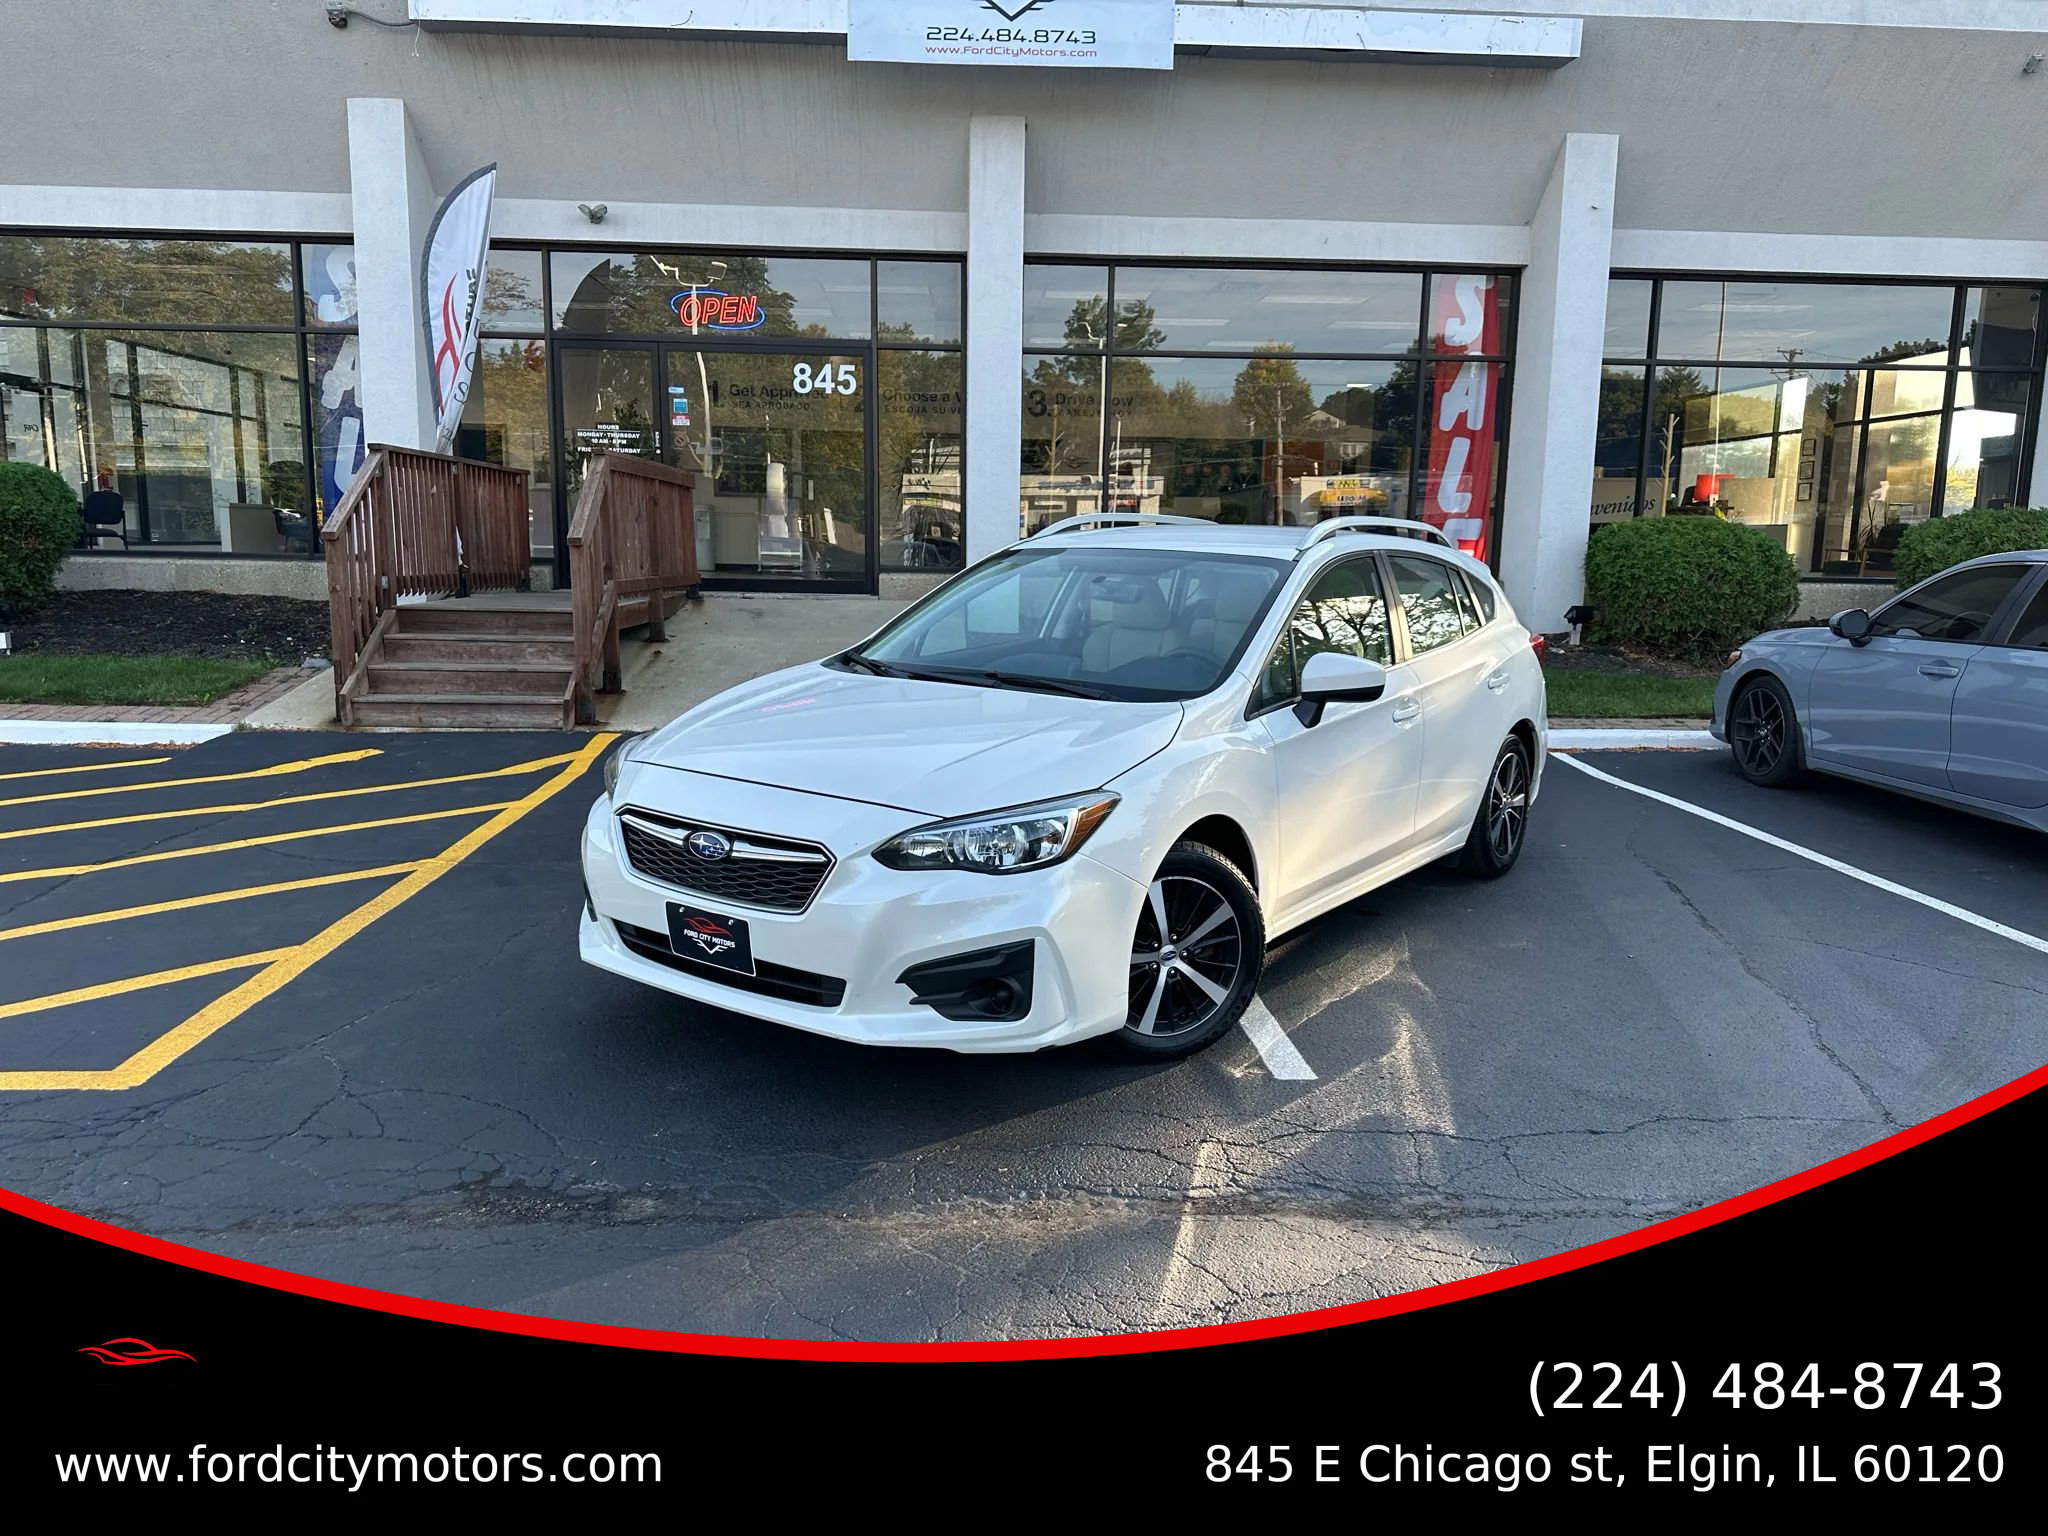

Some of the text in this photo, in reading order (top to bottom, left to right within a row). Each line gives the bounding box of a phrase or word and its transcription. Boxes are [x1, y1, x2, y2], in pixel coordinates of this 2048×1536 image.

[926, 26, 1096, 45] 224.484.8743
[925, 45, 1098, 58] www.FordCityMotors.com
[680, 295, 758, 327] OPEN
[793, 362, 857, 396] 845
[729, 383, 755, 398] Get
[1055, 391, 1095, 406] Drive
[683, 928, 735, 947] FORD CITY MOTORS
